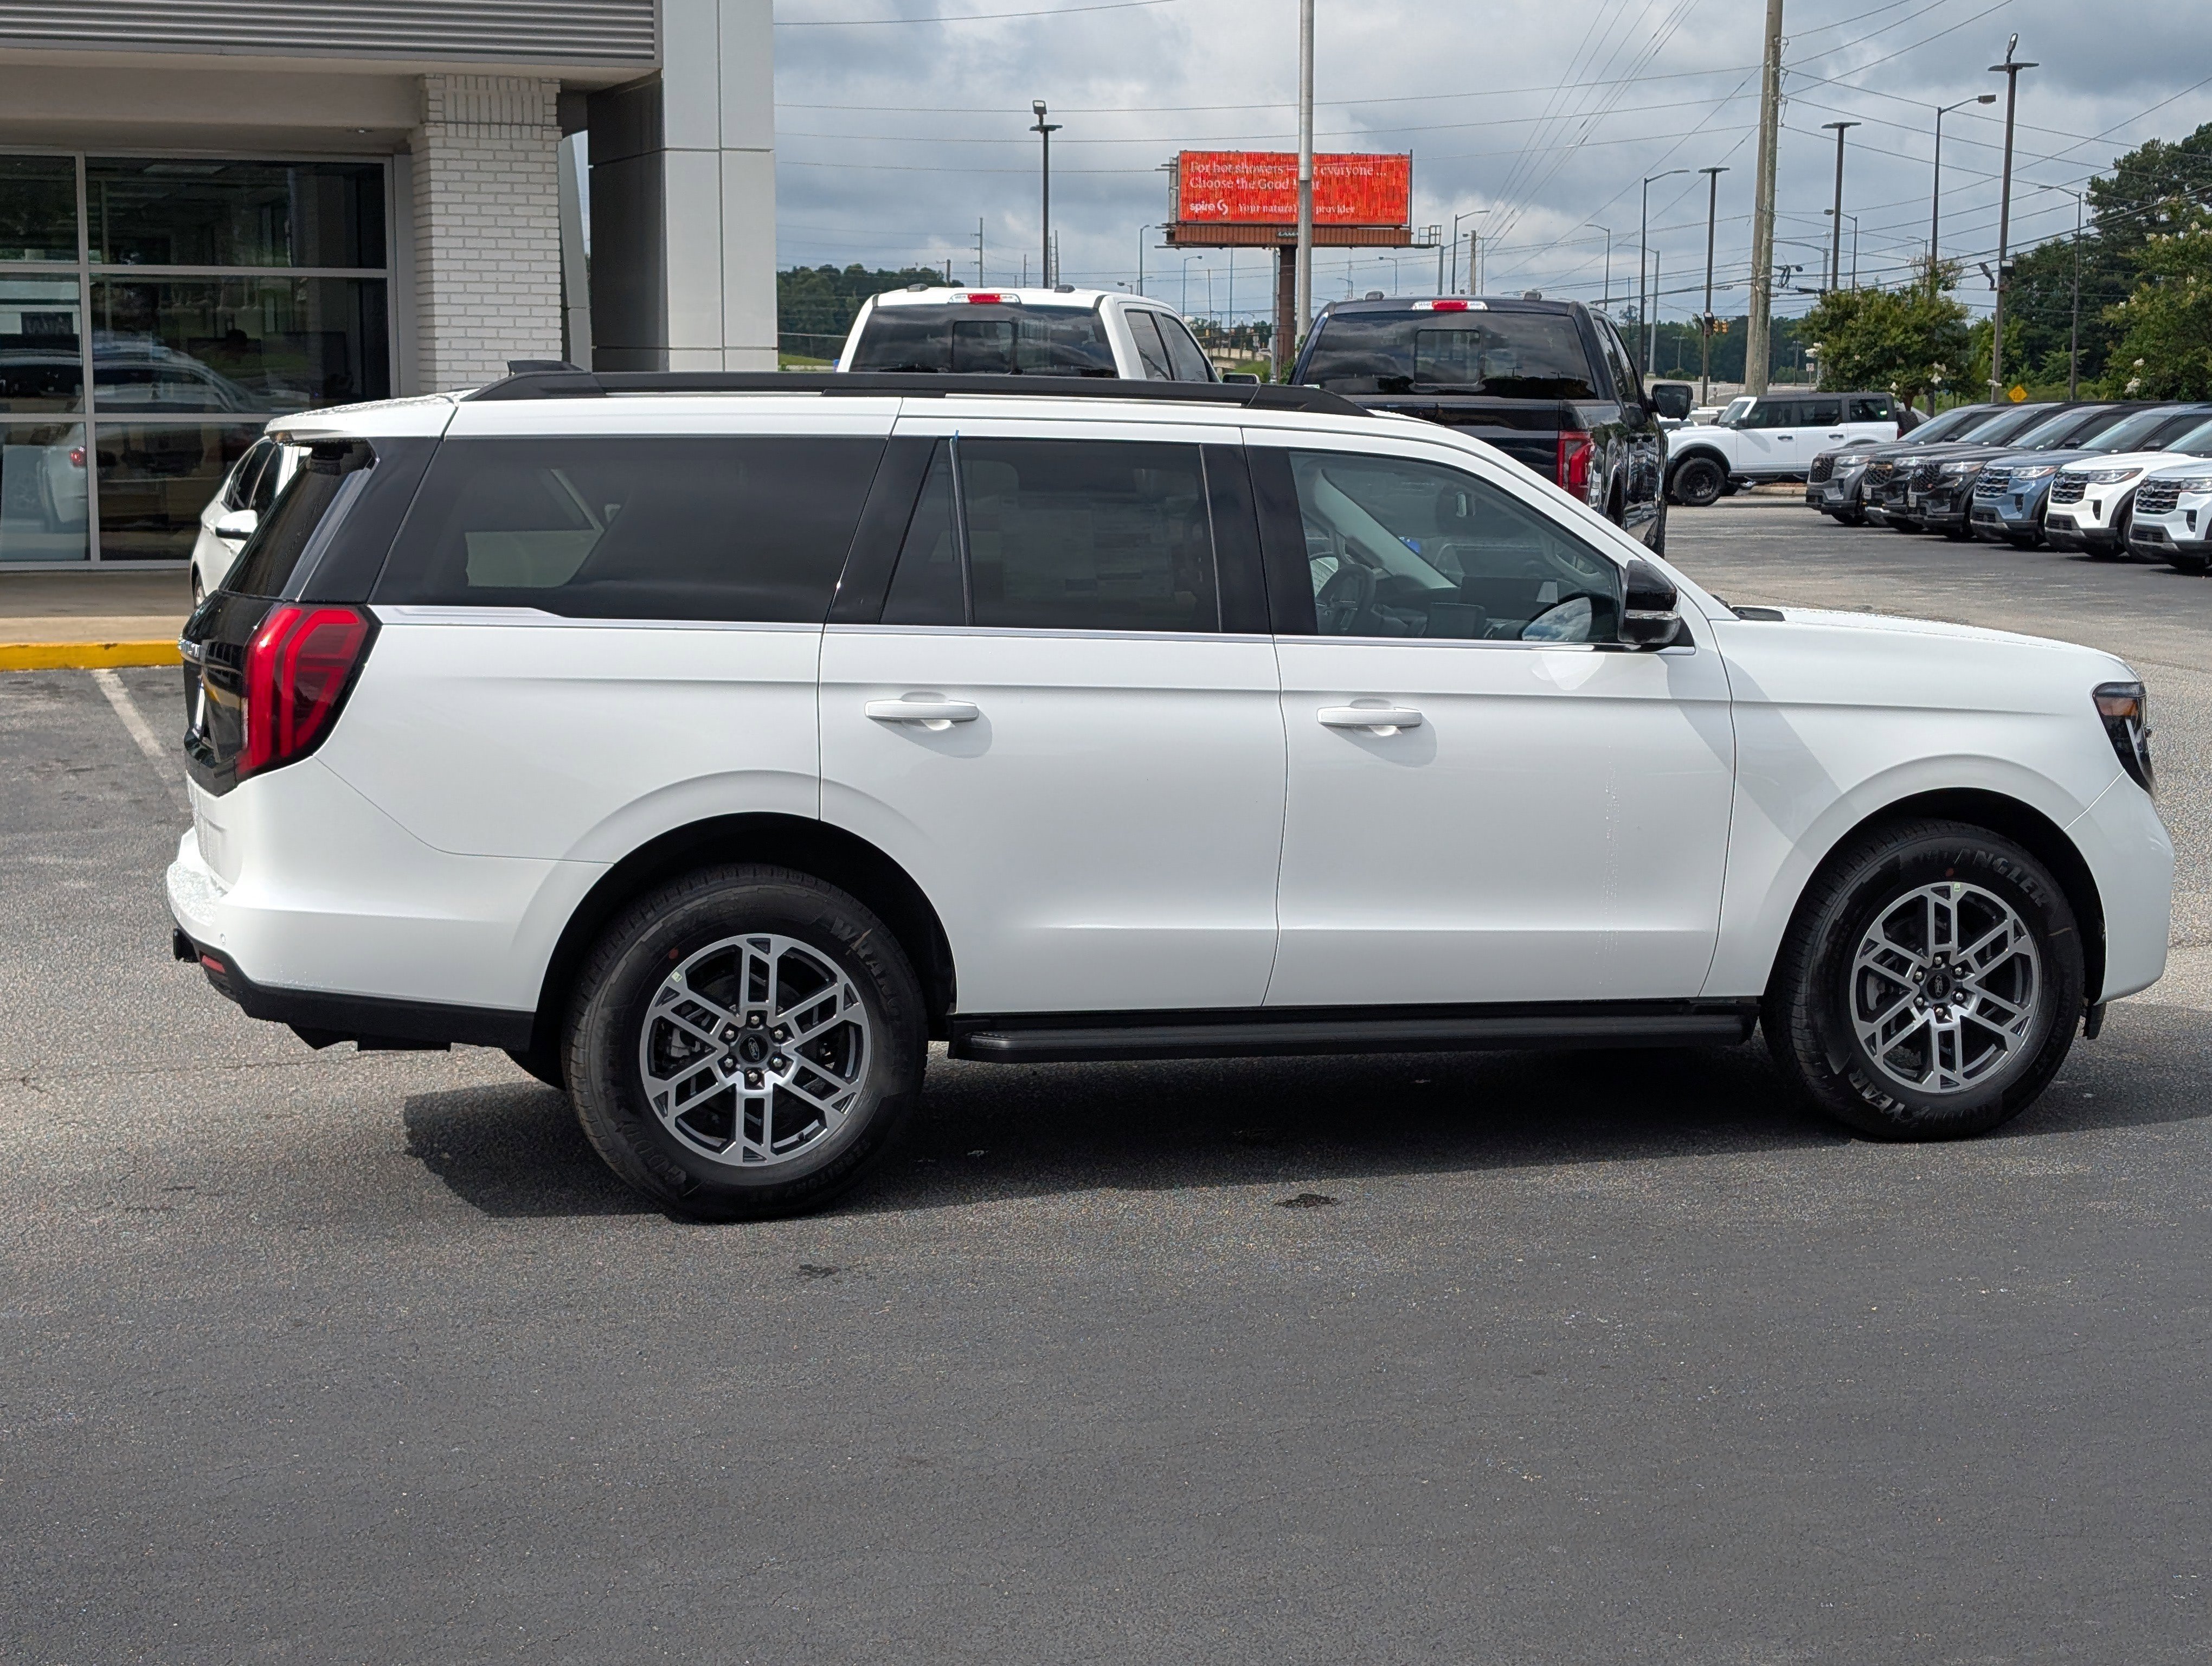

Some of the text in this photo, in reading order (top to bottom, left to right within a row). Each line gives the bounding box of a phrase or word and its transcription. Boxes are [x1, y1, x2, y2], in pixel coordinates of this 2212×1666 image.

[1320, 165, 1373, 177] everyone
[1189, 177, 1233, 189] Choose
[1236, 177, 1255, 189] the
[1258, 178, 1289, 190] Good
[1189, 200, 1216, 214] spire
[1316, 204, 1356, 215] provider
[1930, 845, 2047, 908] NGLER
